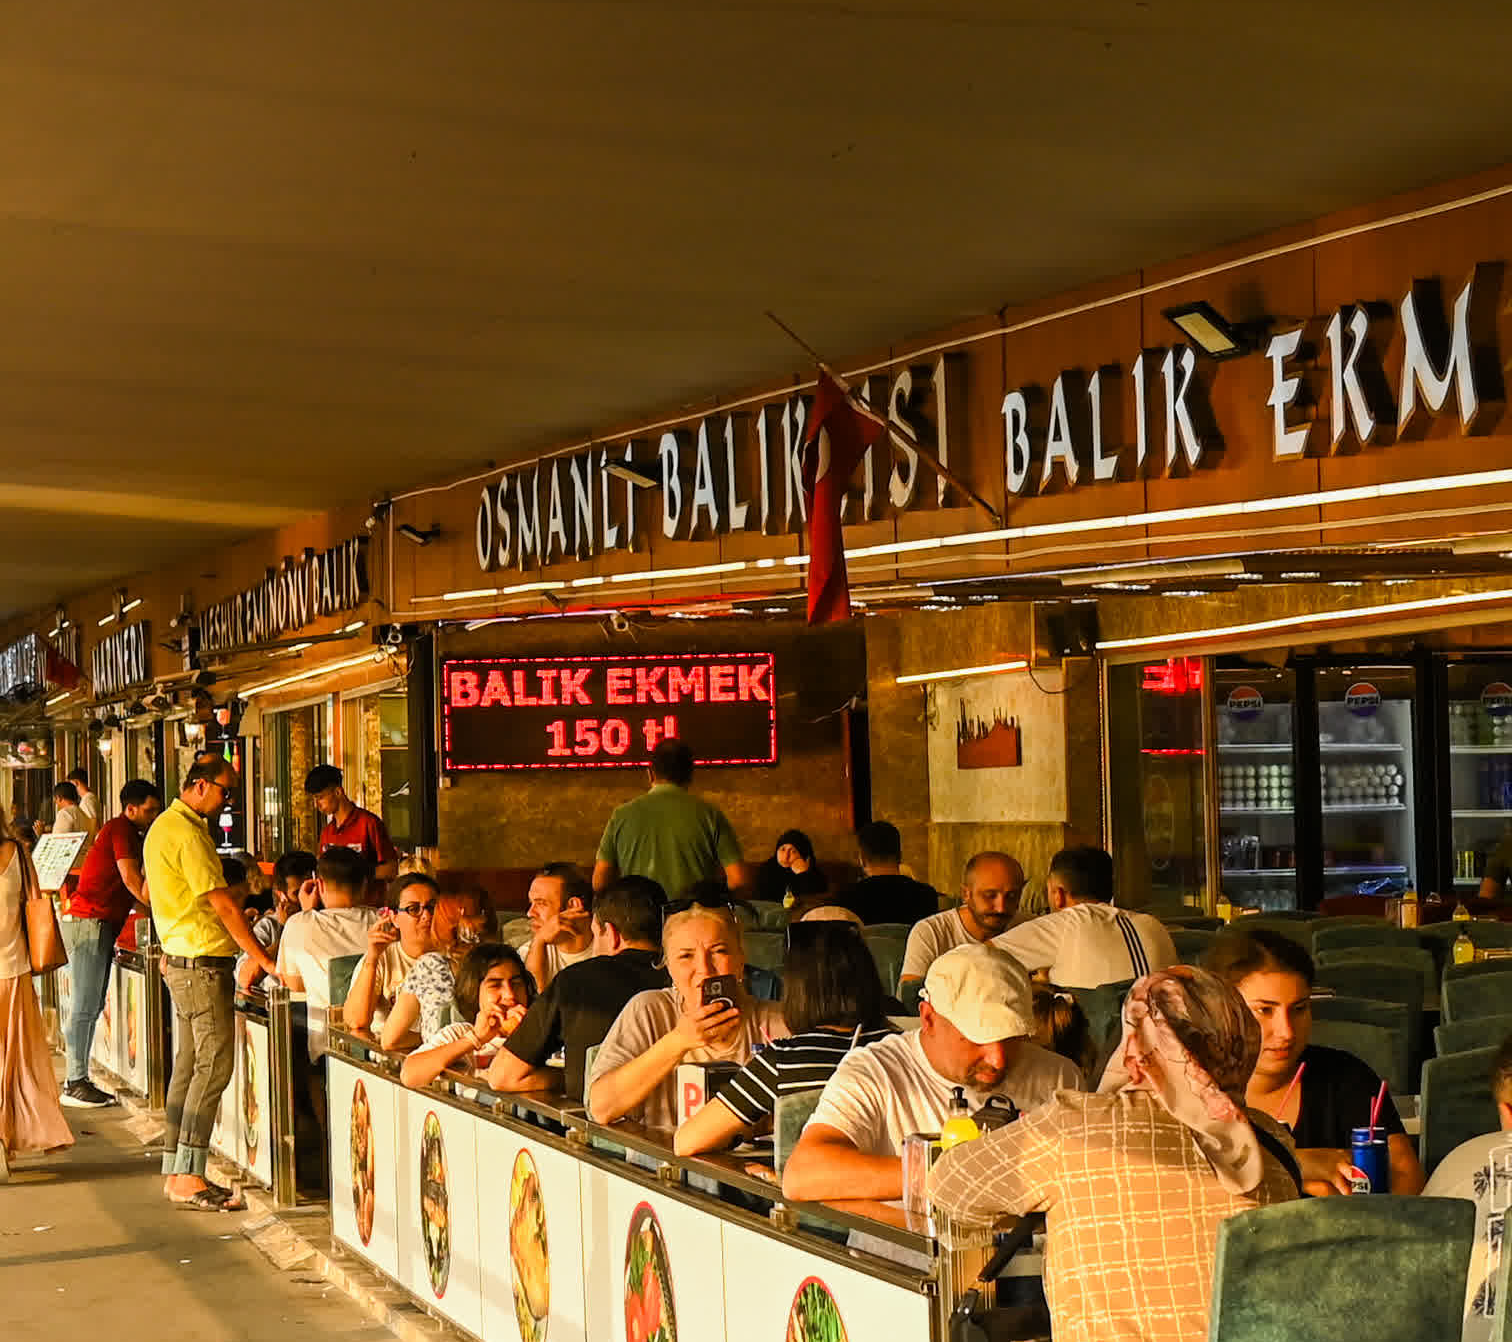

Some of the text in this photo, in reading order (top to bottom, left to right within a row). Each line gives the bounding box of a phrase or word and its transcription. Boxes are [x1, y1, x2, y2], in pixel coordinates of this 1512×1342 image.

[477, 441, 636, 571] OSMANLI
[659, 354, 950, 540] BALIKISI
[1001, 343, 1202, 496] BALIK
[450, 664, 771, 707] BALIK EKMEK
[545, 718, 631, 756] 150
